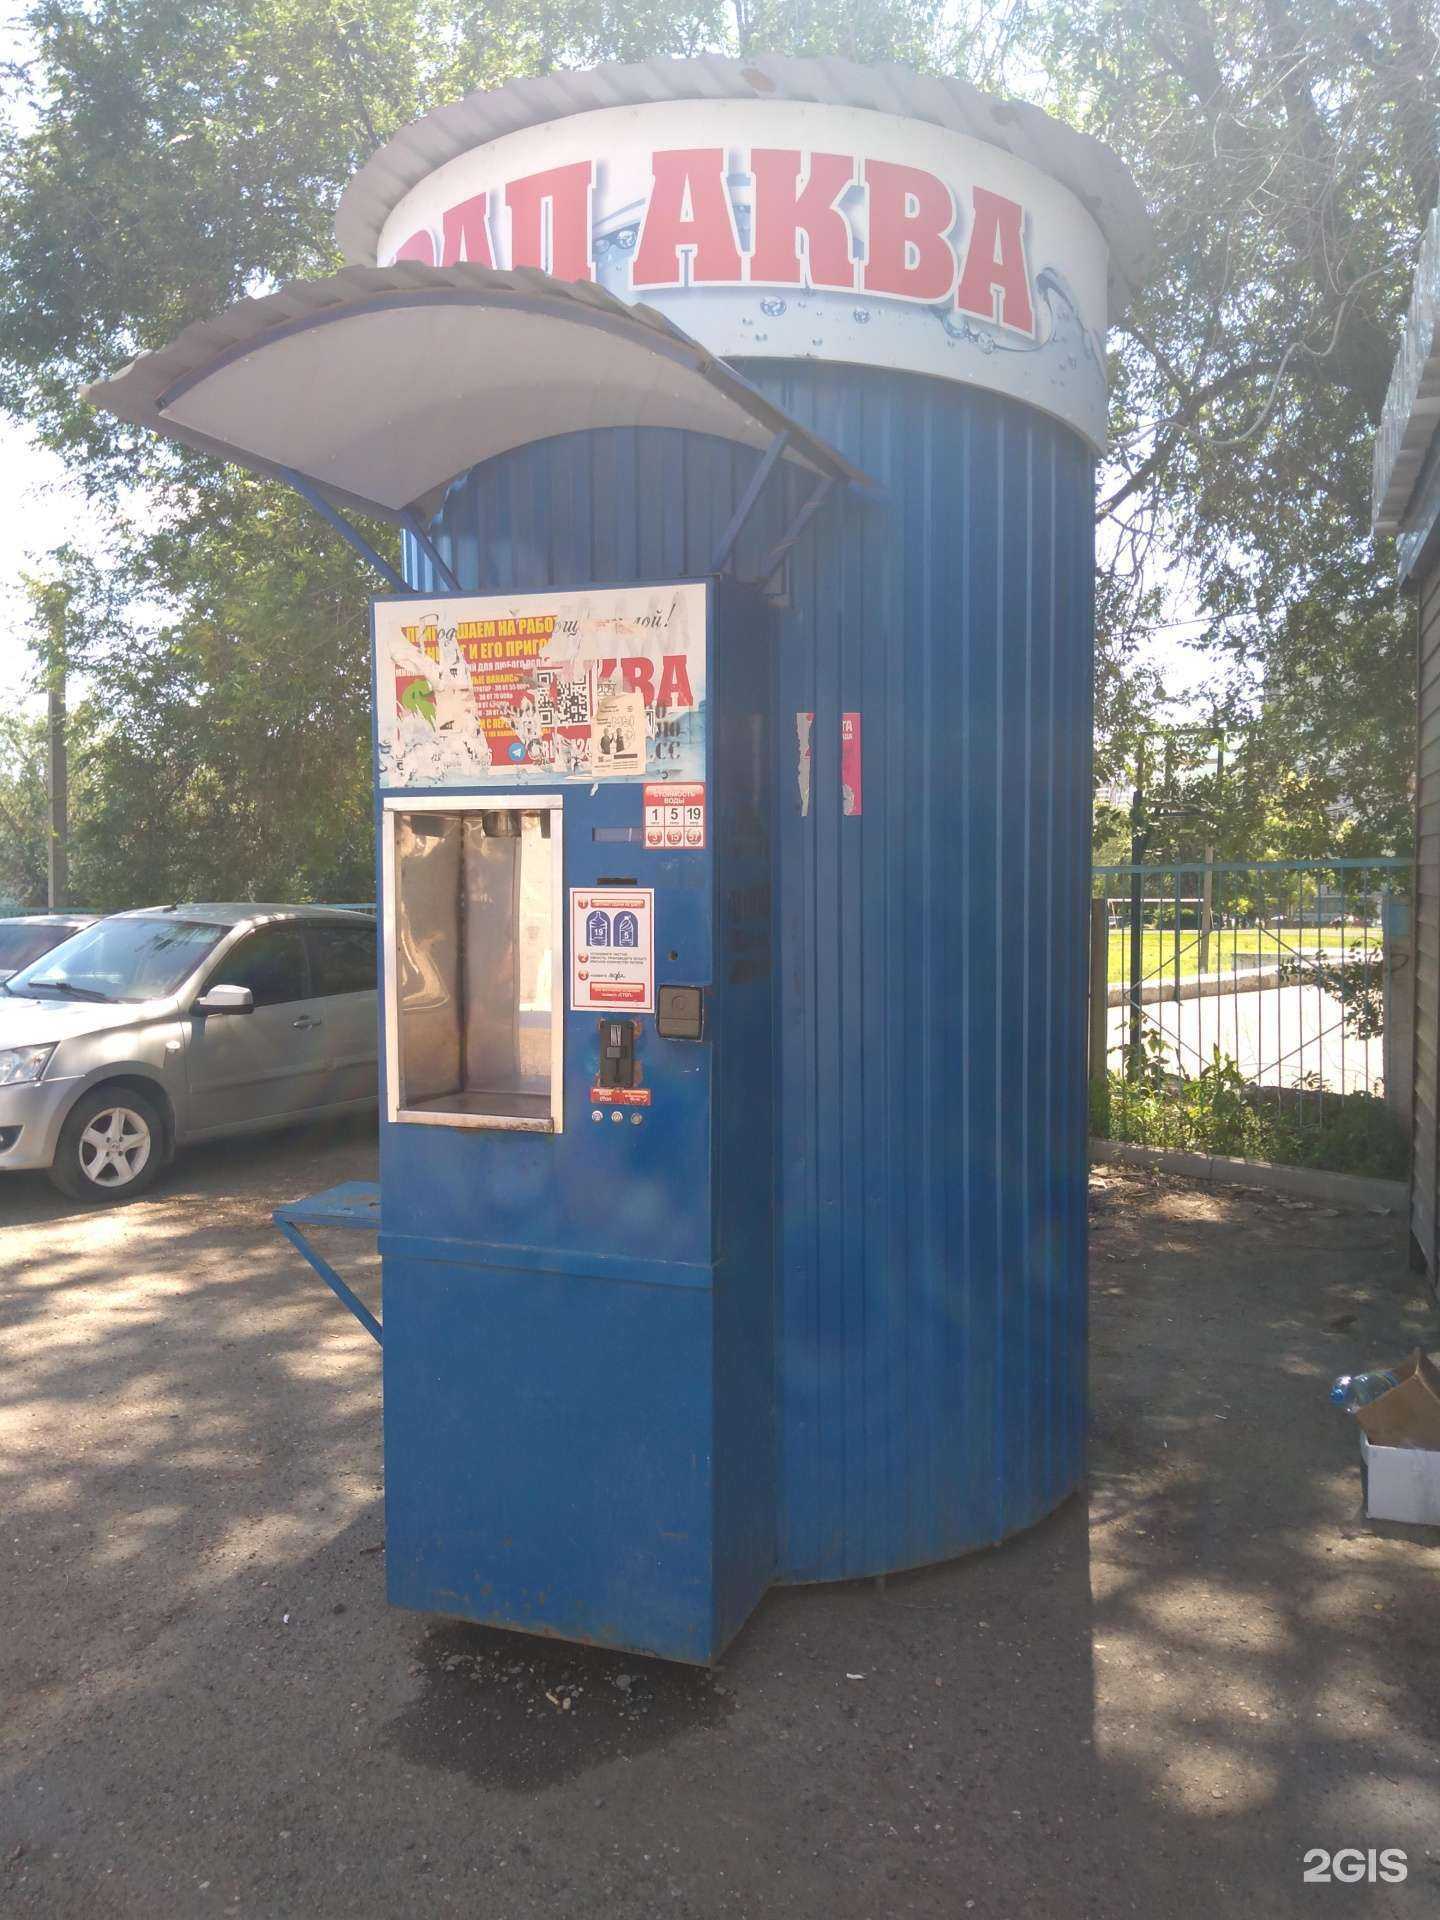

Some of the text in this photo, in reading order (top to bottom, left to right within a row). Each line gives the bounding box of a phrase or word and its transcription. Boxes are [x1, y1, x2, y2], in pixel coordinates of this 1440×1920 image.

[393, 146, 1034, 336] АП АКВА
[498, 619, 516, 636] НА
[519, 616, 558, 634] РАБО
[480, 641, 503, 659] ЕГО
[664, 797, 685, 805] ВОДЫ
[652, 807, 701, 821] 1 5 19
